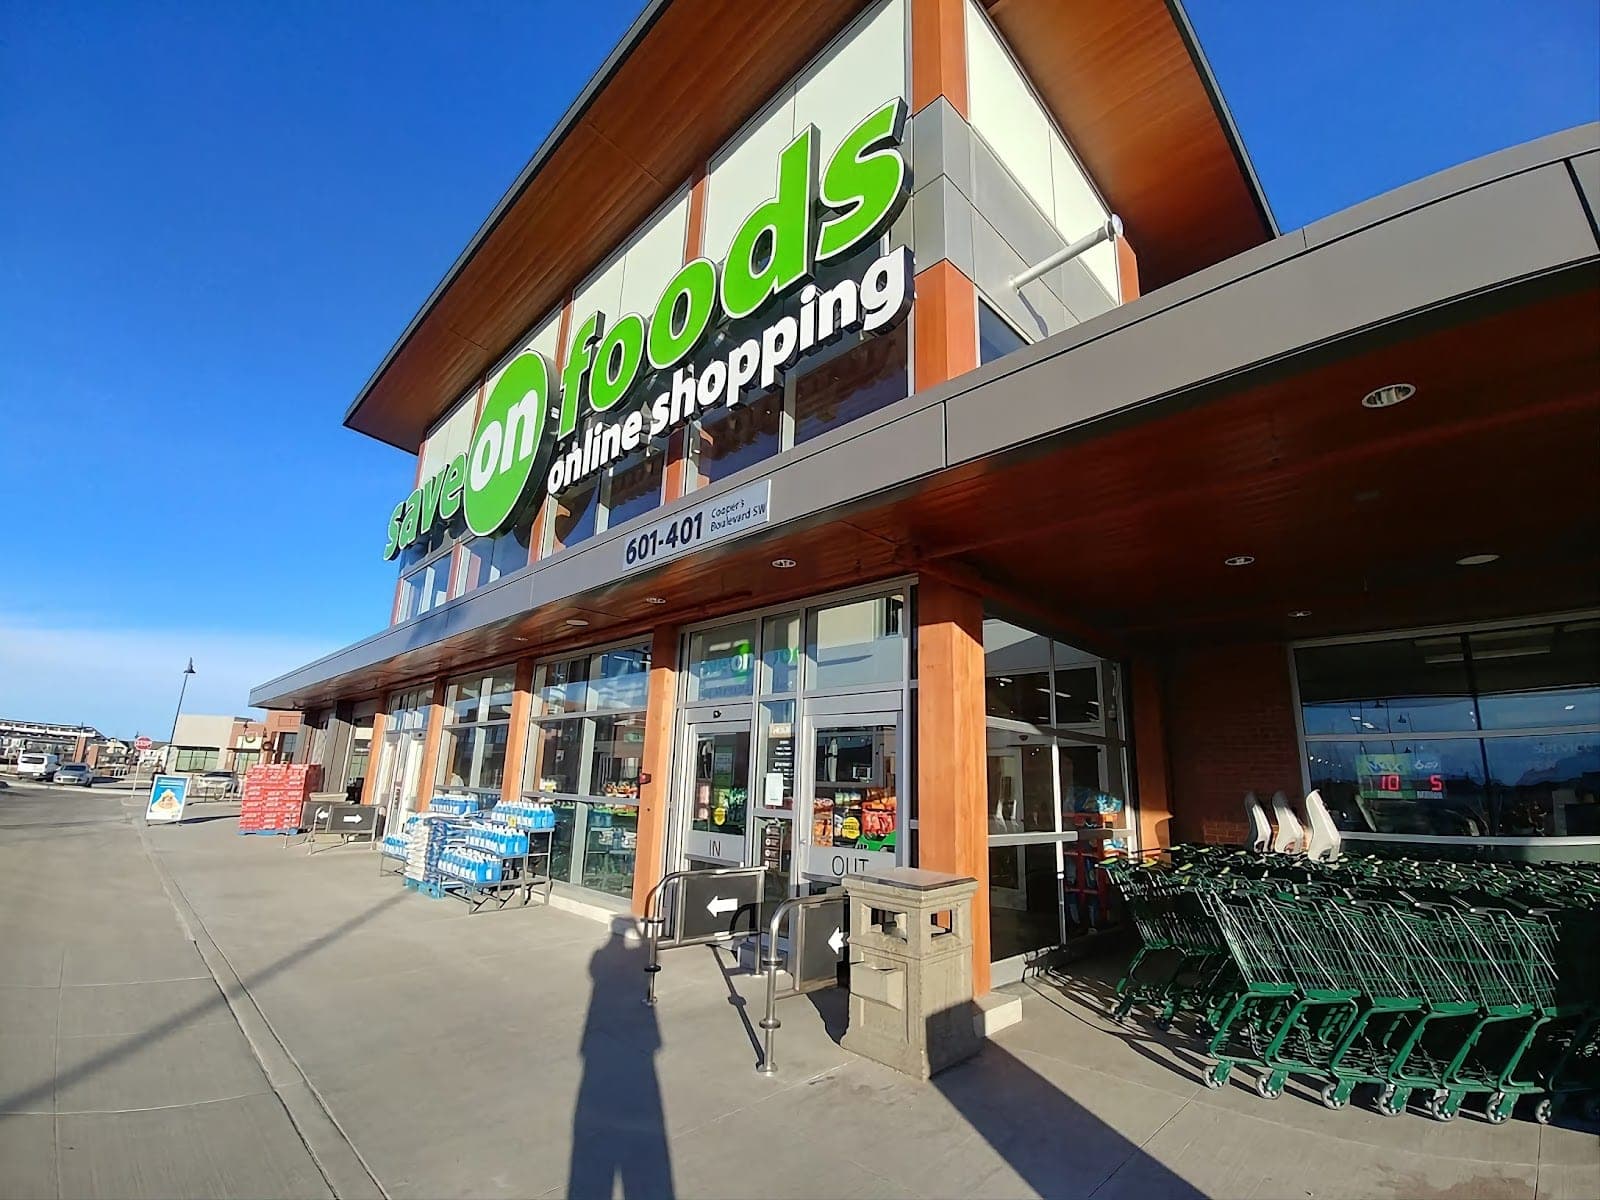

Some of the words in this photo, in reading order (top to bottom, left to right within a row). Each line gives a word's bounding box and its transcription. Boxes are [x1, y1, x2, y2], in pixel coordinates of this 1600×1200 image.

[384, 452, 467, 560] save
[470, 389, 539, 492] on
[556, 96, 907, 441] foods
[547, 409, 642, 494] online
[650, 244, 907, 437] shopping
[710, 510, 751, 532] Boulevard
[753, 503, 766, 517] SW
[625, 511, 703, 565] 601-401
[1381, 774, 1399, 790] 10
[1430, 775, 1443, 791] 5
[708, 840, 721, 857] IN
[831, 855, 869, 876] OUT
